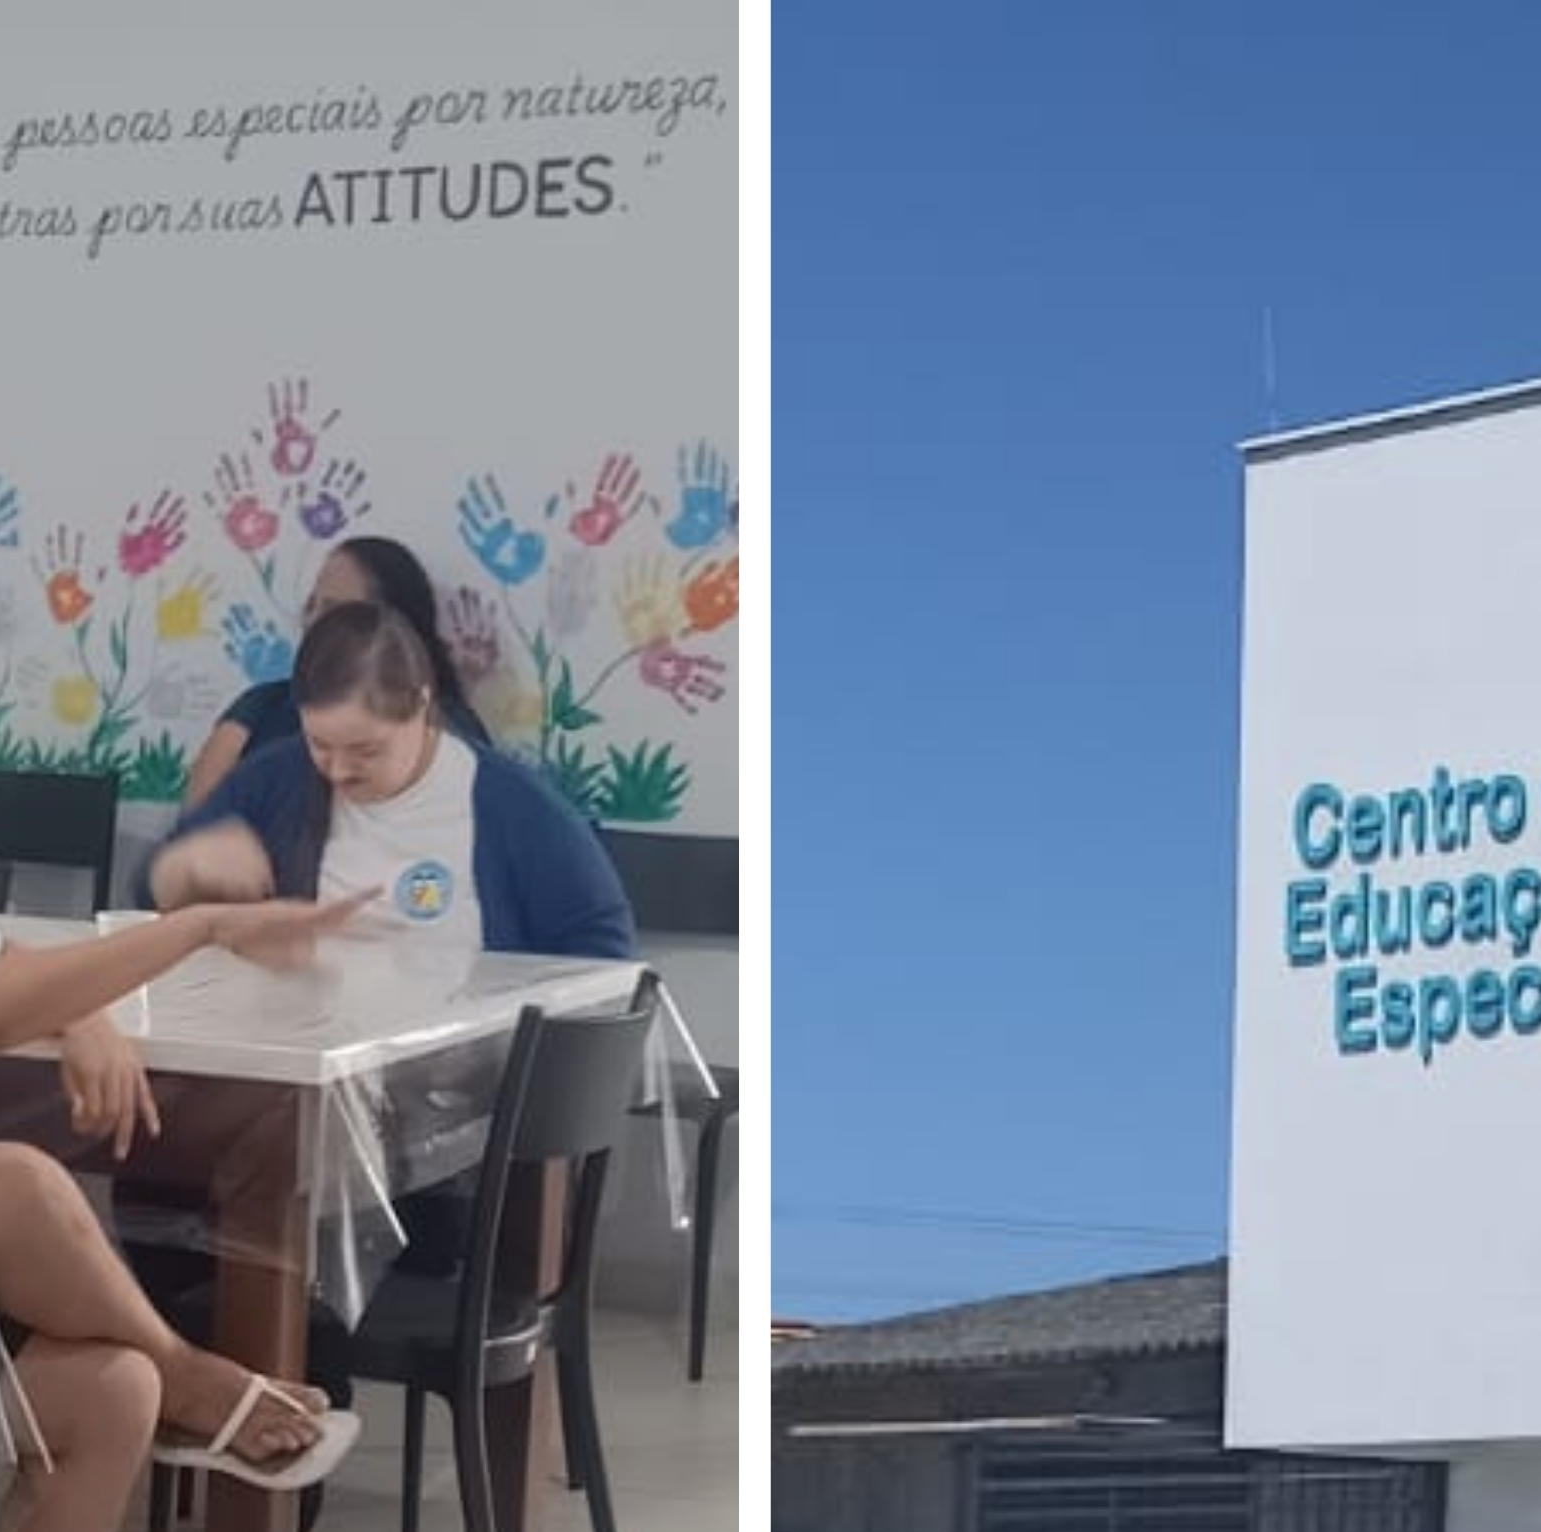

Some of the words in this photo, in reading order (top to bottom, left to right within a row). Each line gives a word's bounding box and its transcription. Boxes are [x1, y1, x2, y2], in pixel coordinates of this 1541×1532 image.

[183, 84, 383, 162] especiais
[390, 90, 489, 153] por
[503, 74, 727, 137] natureza,
[86, 203, 173, 260] por
[174, 193, 283, 233] suas
[1295, 766, 1527, 869] Centro
